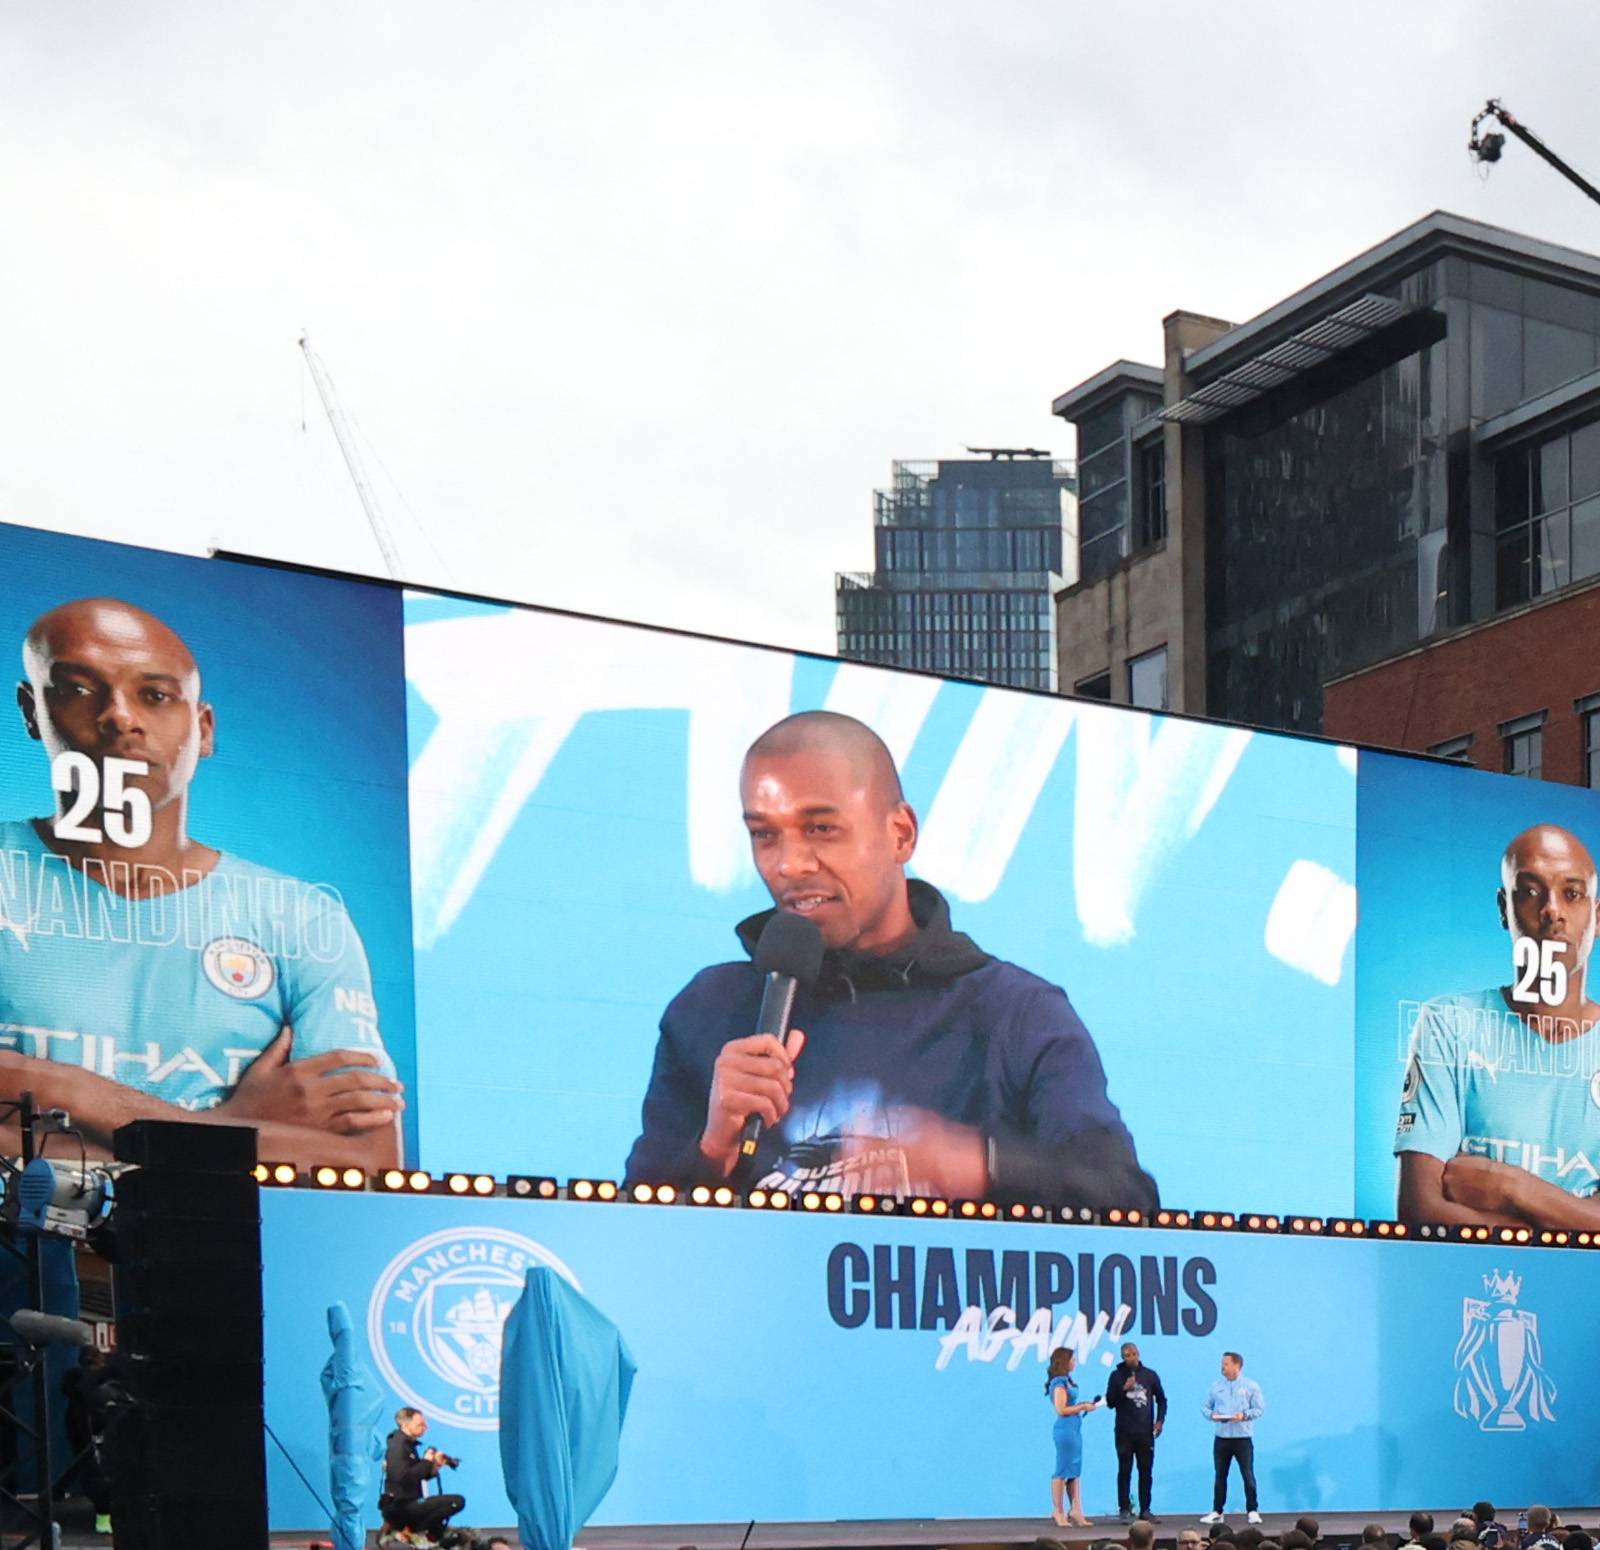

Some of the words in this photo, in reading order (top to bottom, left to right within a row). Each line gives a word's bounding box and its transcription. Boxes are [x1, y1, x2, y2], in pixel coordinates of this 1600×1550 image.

[51, 750, 154, 848] 25
[1512, 935, 1569, 1007] 25
[394, 1243, 537, 1303] MANCHES
[826, 1241, 1218, 1338] CHAMPIONS
[454, 1394, 500, 1414] CIT
